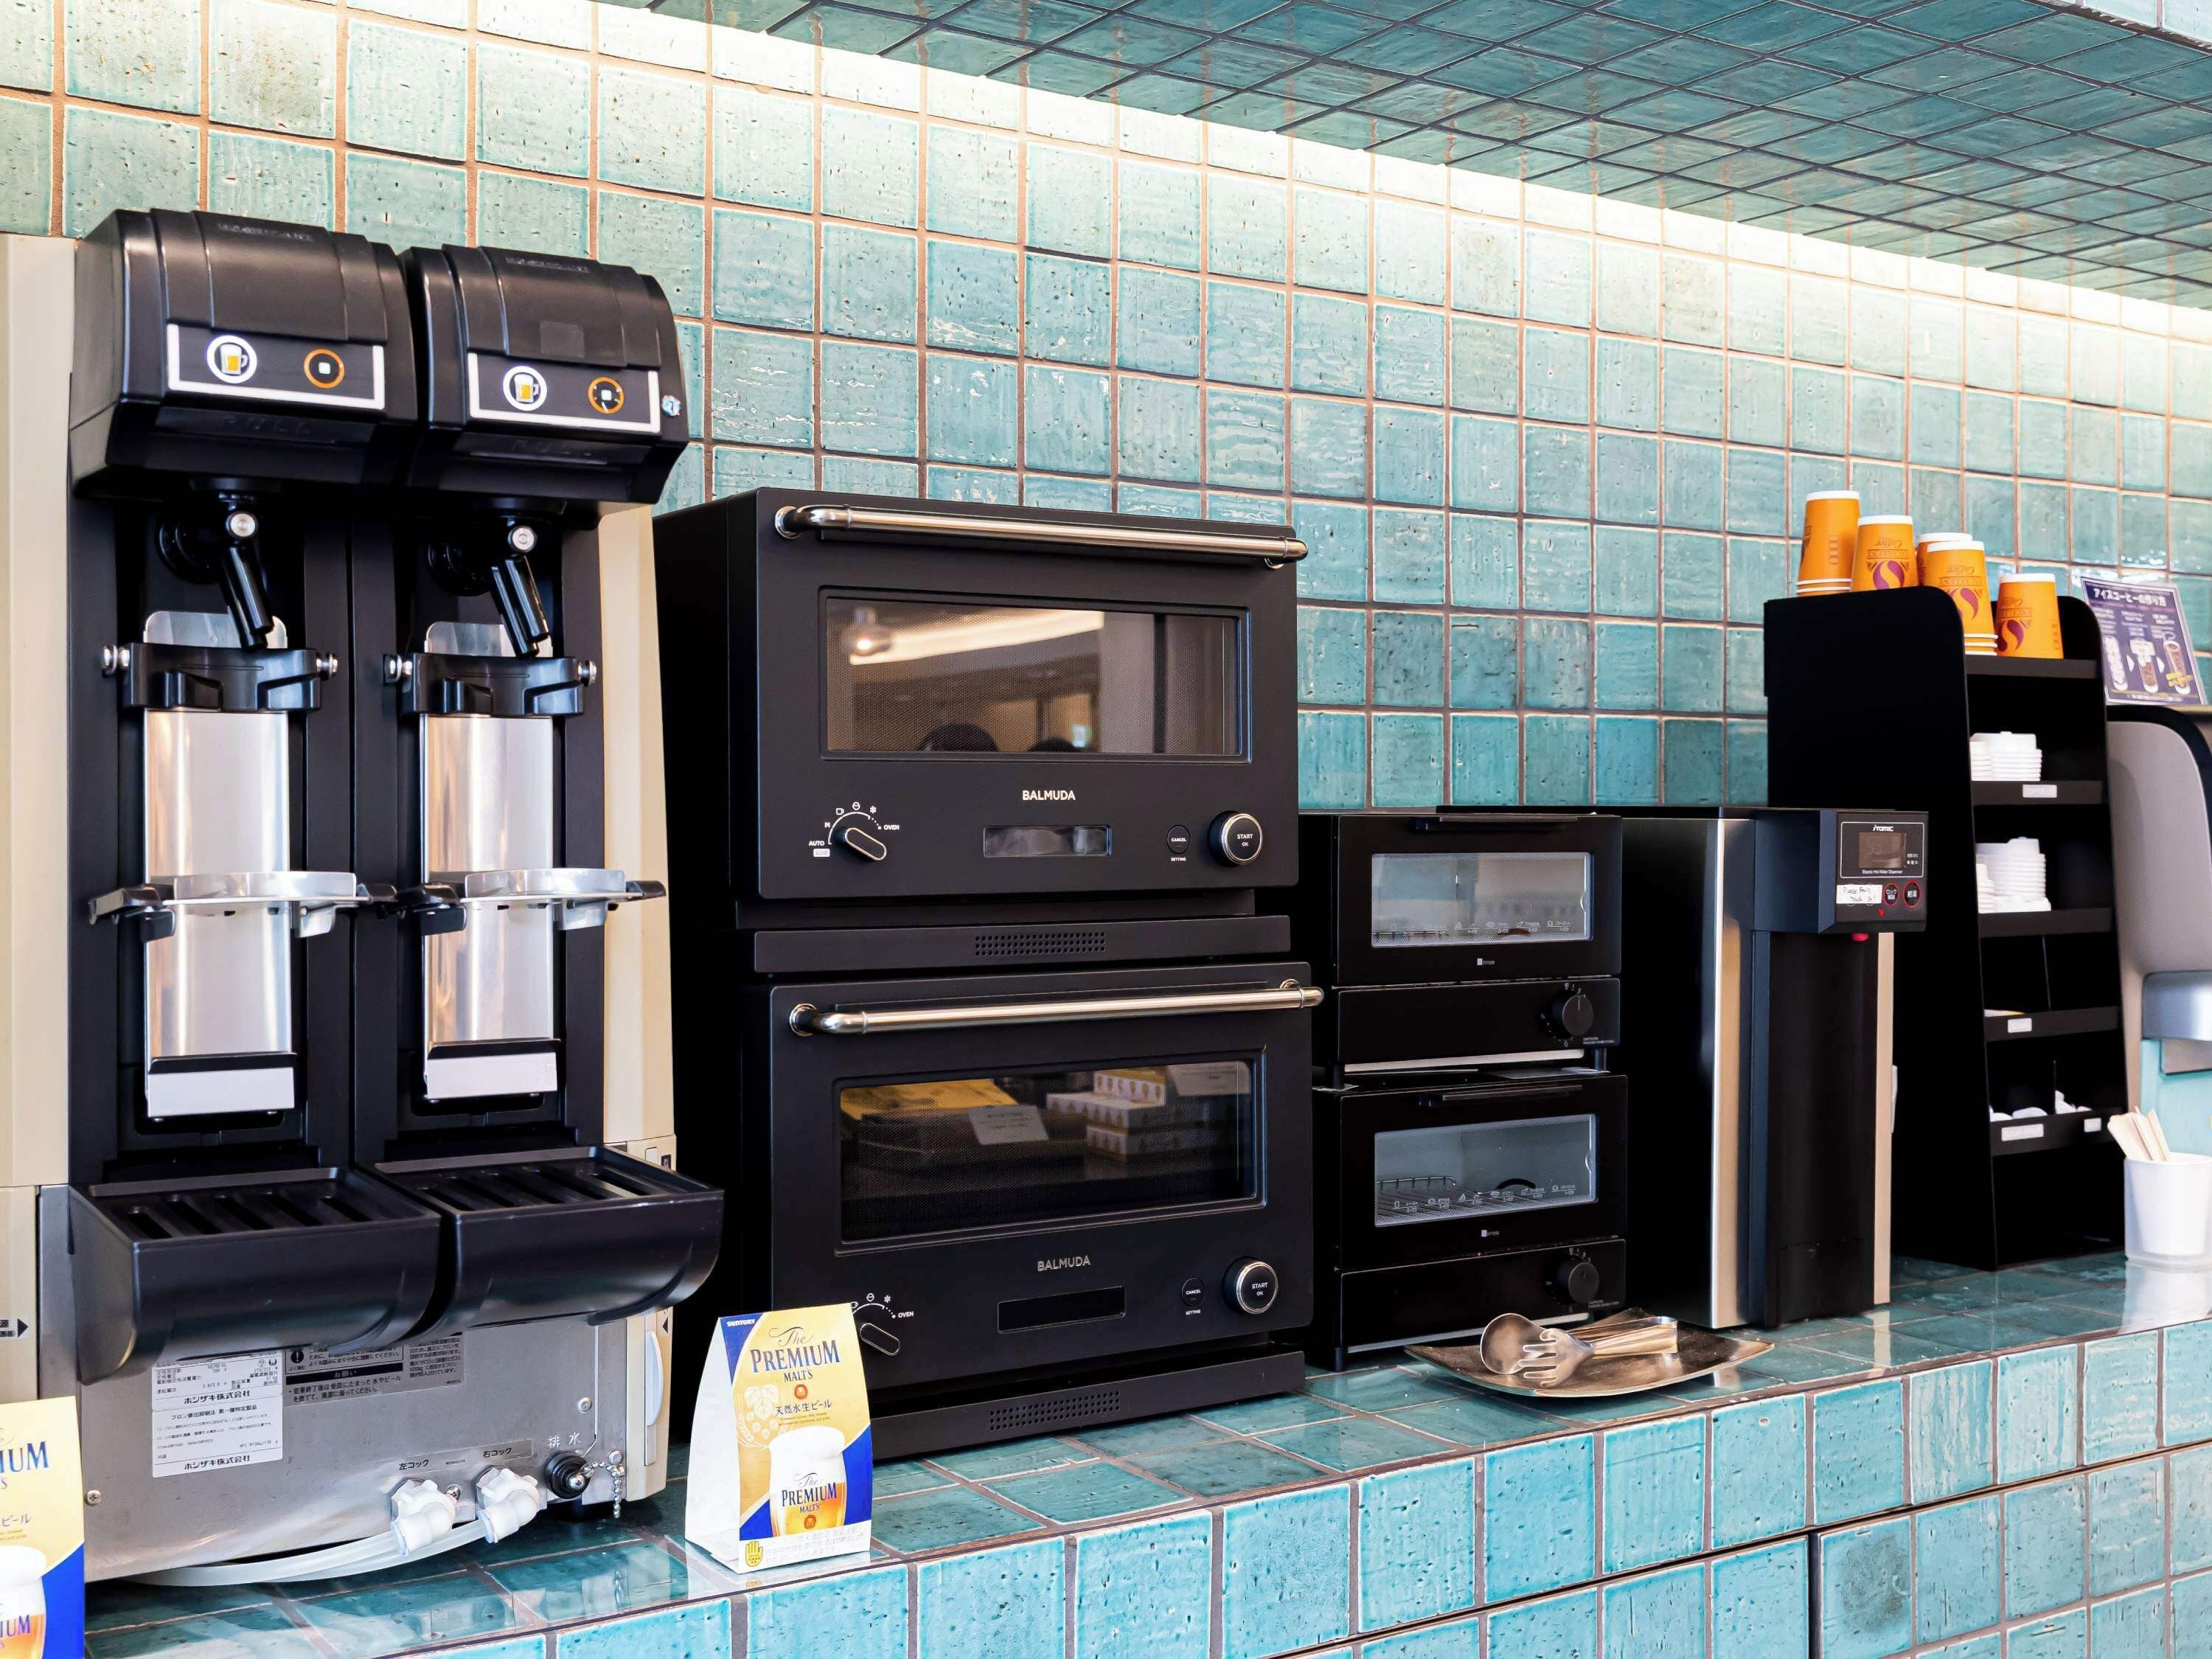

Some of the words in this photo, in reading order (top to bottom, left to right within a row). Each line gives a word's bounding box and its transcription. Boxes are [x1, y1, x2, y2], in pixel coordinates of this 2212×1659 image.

[1022, 790, 1076, 801] BALMUDA
[1037, 1255, 1091, 1271] BALMUDA
[768, 1326, 814, 1347] The
[750, 1340, 841, 1373] PREMIUM
[784, 1368, 813, 1383] MALT'S
[184, 1390, 251, 1405] ホシザキ株式会社
[482, 1447, 512, 1458] 右コック
[184, 1455, 251, 1470] ホシザキ株式会社
[399, 1459, 430, 1471] 左コック
[793, 1472, 820, 1488] The
[782, 1482, 837, 1506] PREMIUM
[799, 1503, 820, 1514] MALT'S
